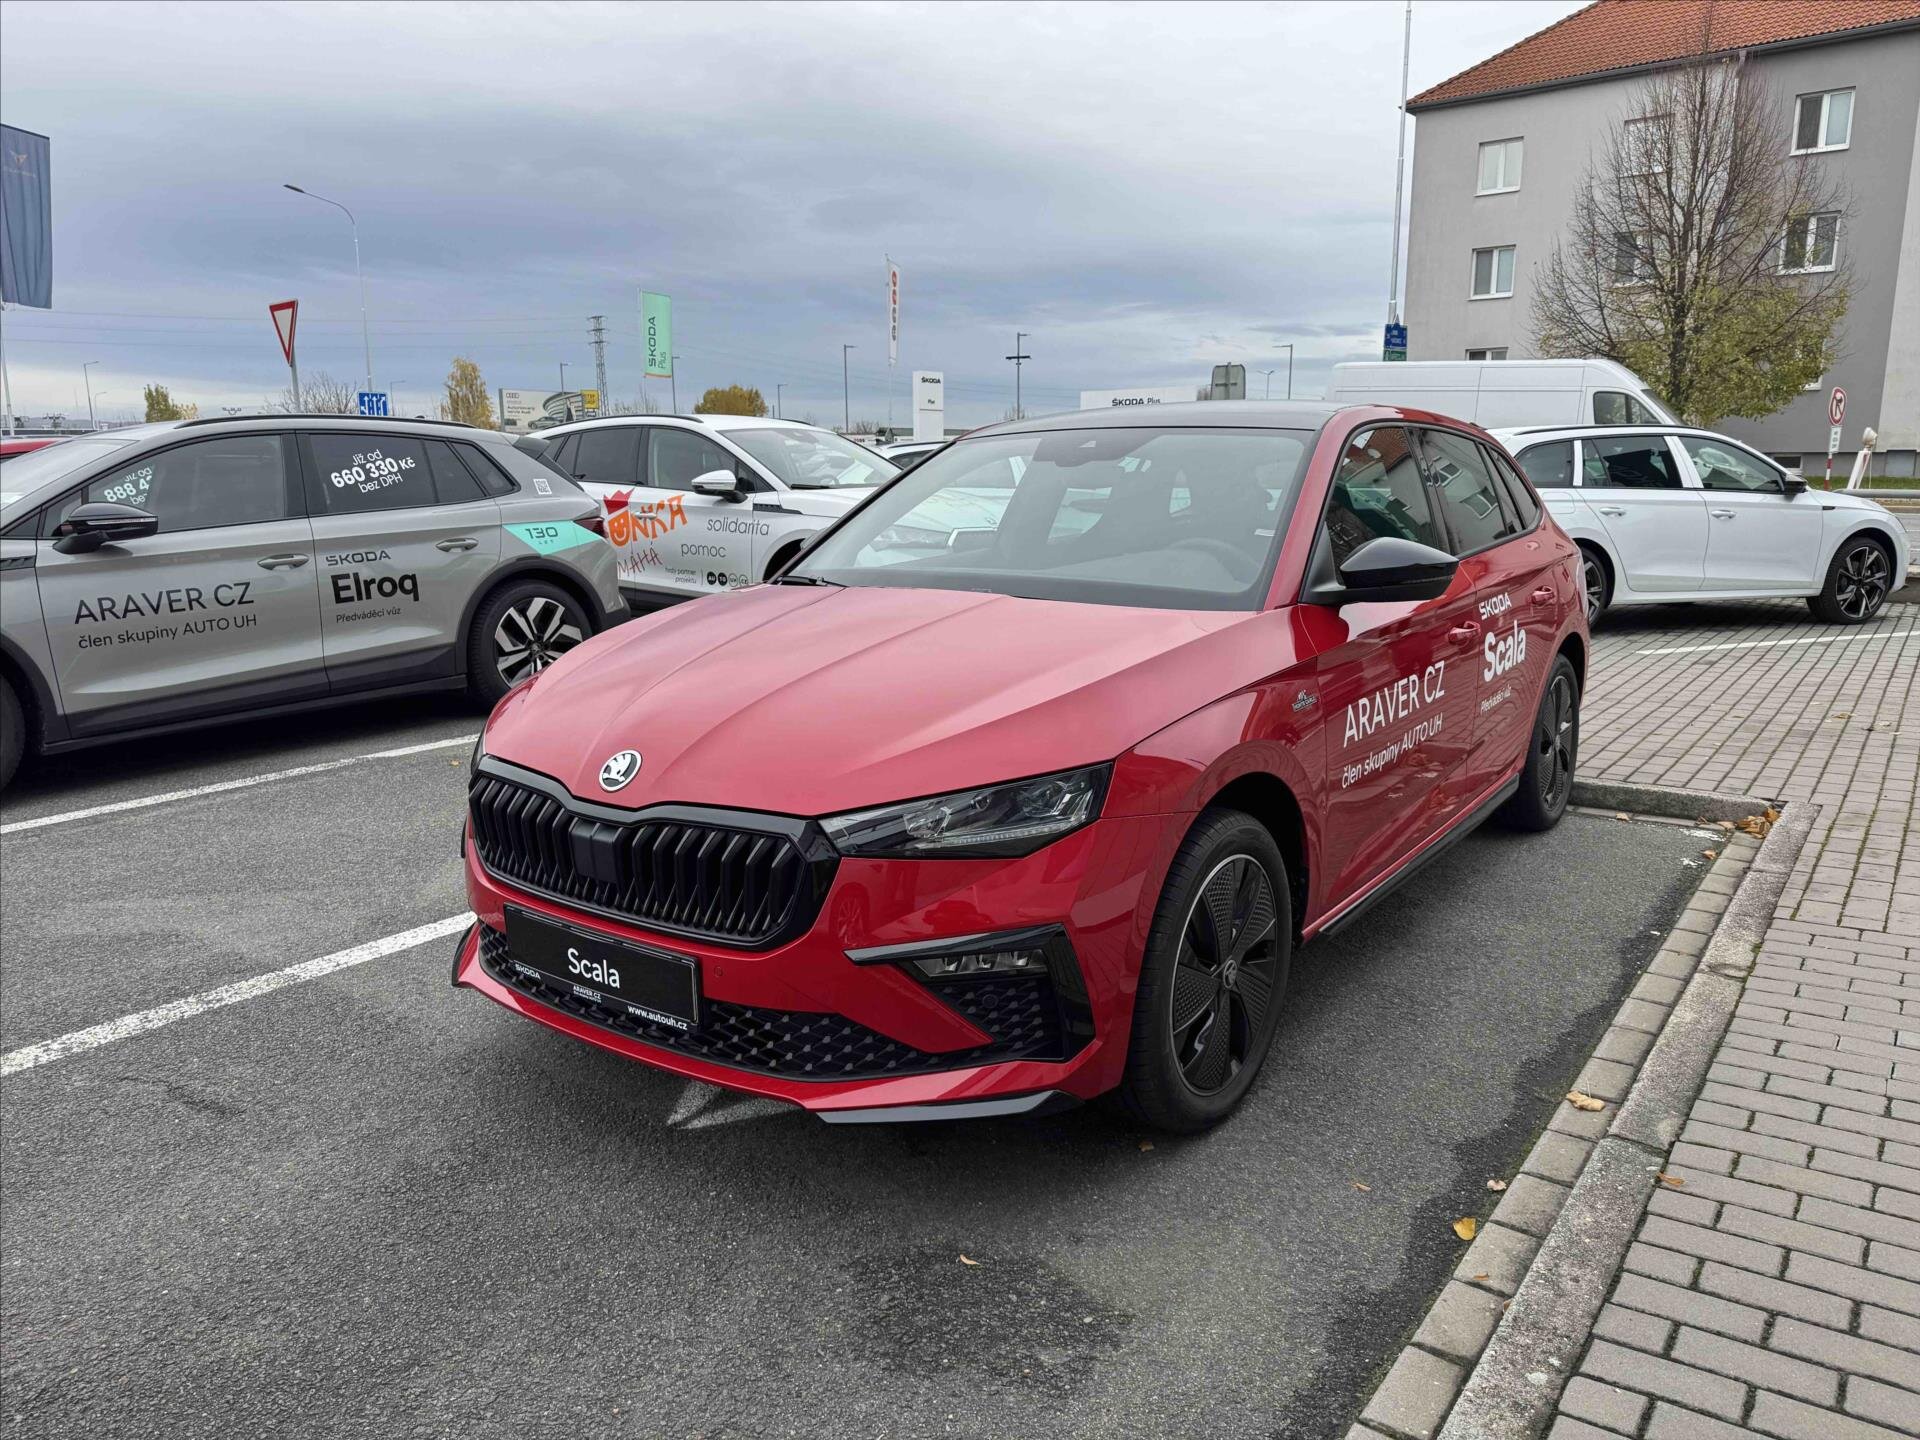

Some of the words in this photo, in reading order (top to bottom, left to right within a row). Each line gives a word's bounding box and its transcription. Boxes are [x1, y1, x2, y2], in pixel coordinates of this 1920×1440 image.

[657, 351, 667, 369] Plus
[1111, 397, 1144, 407] ŠKODA
[367, 449, 383, 461] od
[330, 466, 366, 488] 660
[365, 457, 399, 478] 330
[398, 456, 416, 470] Kč
[357, 480, 381, 493] bez
[379, 472, 403, 487] DPH
[104, 482, 137, 502] 888
[525, 526, 558, 539] 130
[707, 516, 770, 536] solidarita
[681, 543, 727, 558] pomoc
[330, 571, 420, 604] Elroq
[74, 587, 207, 625] ARAVER
[213, 581, 254, 607] CZ
[78, 633, 113, 649] člen
[117, 626, 178, 643] skupiny
[182, 617, 230, 635] AUTO
[234, 614, 257, 629] UH
[1483, 619, 1526, 682] Scala
[1343, 674, 1420, 748] ARAVER
[1424, 660, 1445, 704] CZ
[1341, 764, 1362, 789] člen
[1363, 741, 1401, 775] skupiny
[1400, 721, 1428, 754] AUTO
[1429, 712, 1443, 736] UH
[567, 947, 620, 989] Scala
[627, 1004, 688, 1031] www.autouh.cz
